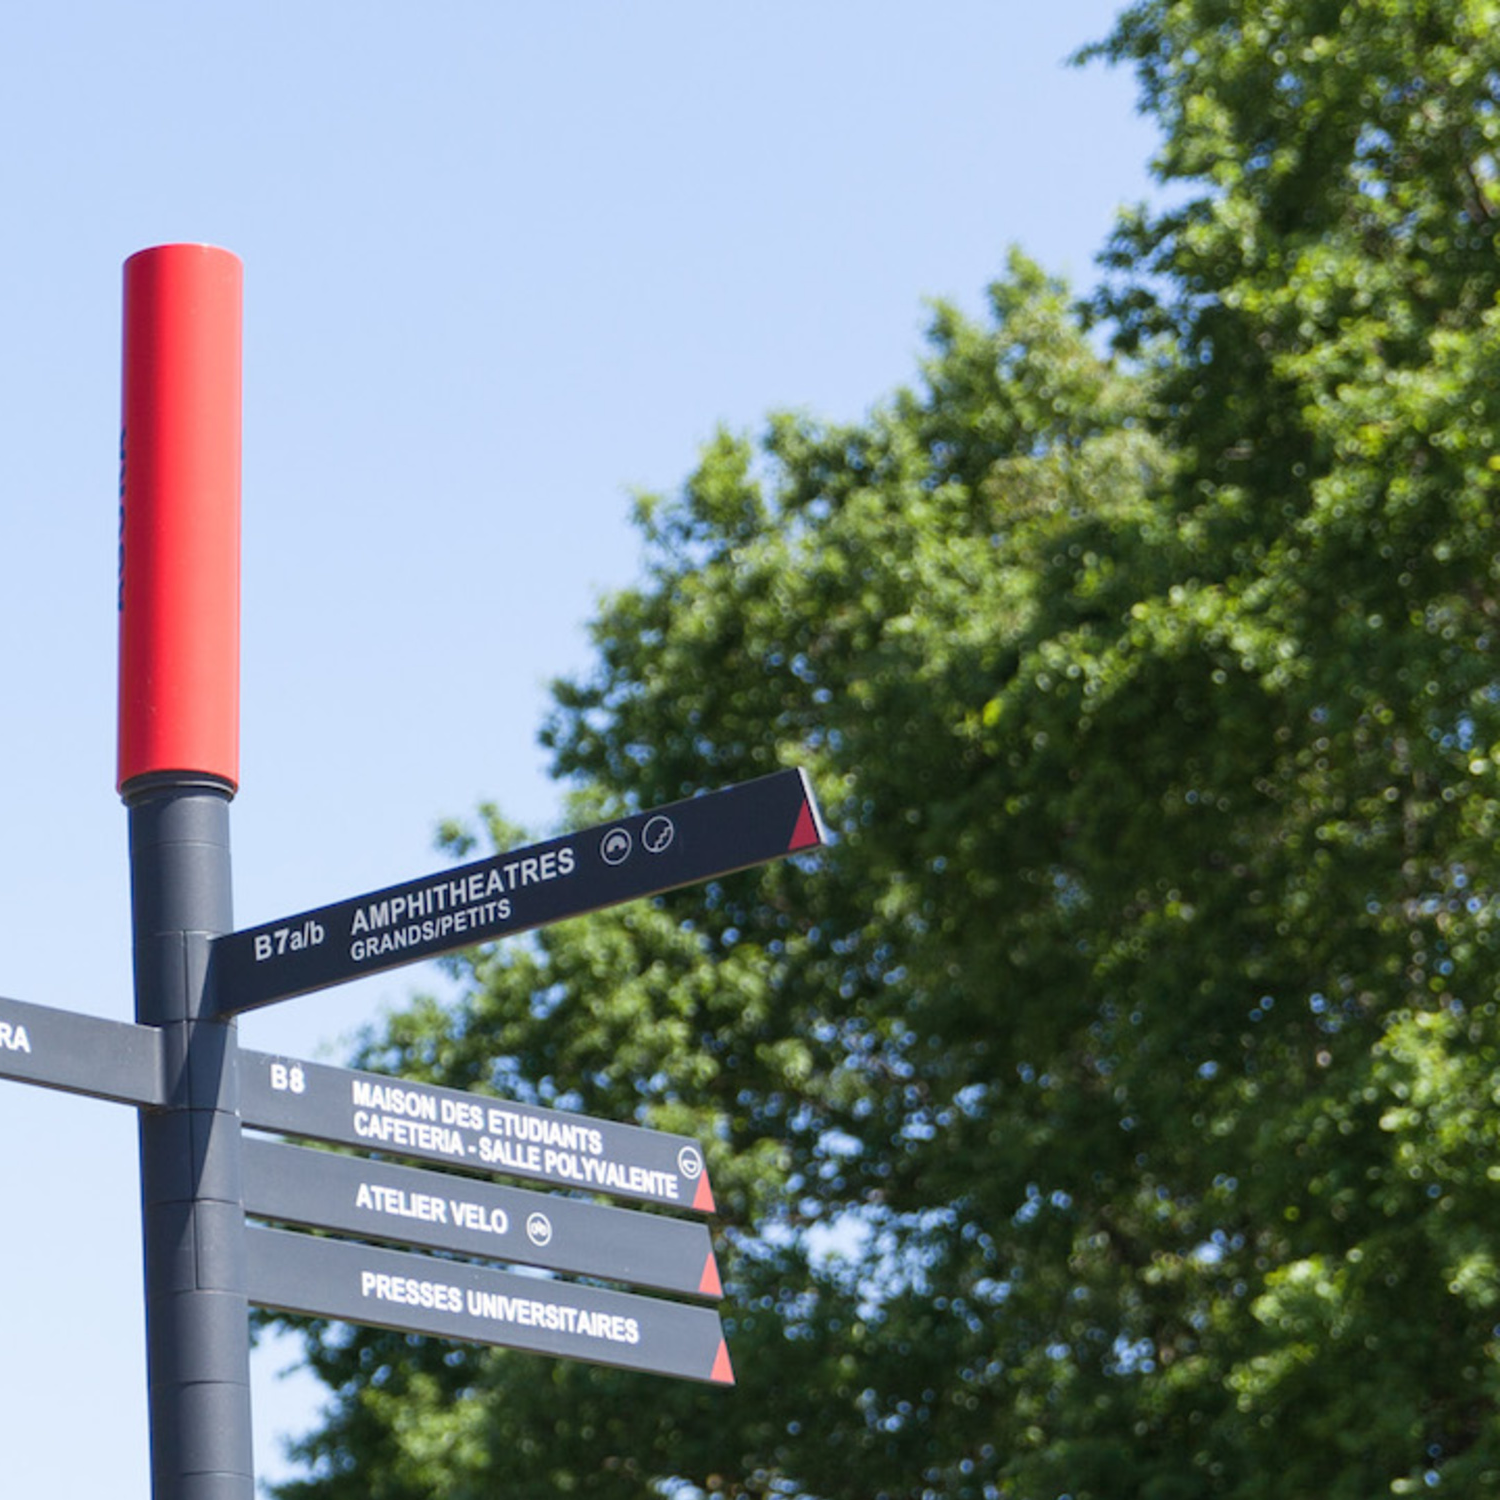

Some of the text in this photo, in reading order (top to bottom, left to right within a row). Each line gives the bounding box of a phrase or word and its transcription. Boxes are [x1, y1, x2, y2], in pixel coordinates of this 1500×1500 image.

[351, 847, 575, 936] AMPHITHEATRES
[255, 921, 325, 961] B7a/b
[351, 898, 512, 961] GRANDS/PETITS
[352, 1080, 603, 1155] MAISON DES ETUDIANTS
[354, 1110, 465, 1157] CAFETERIA
[479, 1138, 542, 1172] SALLE
[544, 1149, 680, 1199] POLYVALENTE
[356, 1183, 509, 1234] ATELIER VELO
[361, 1271, 641, 1344] PRESSES UNIVERSITAIRES
